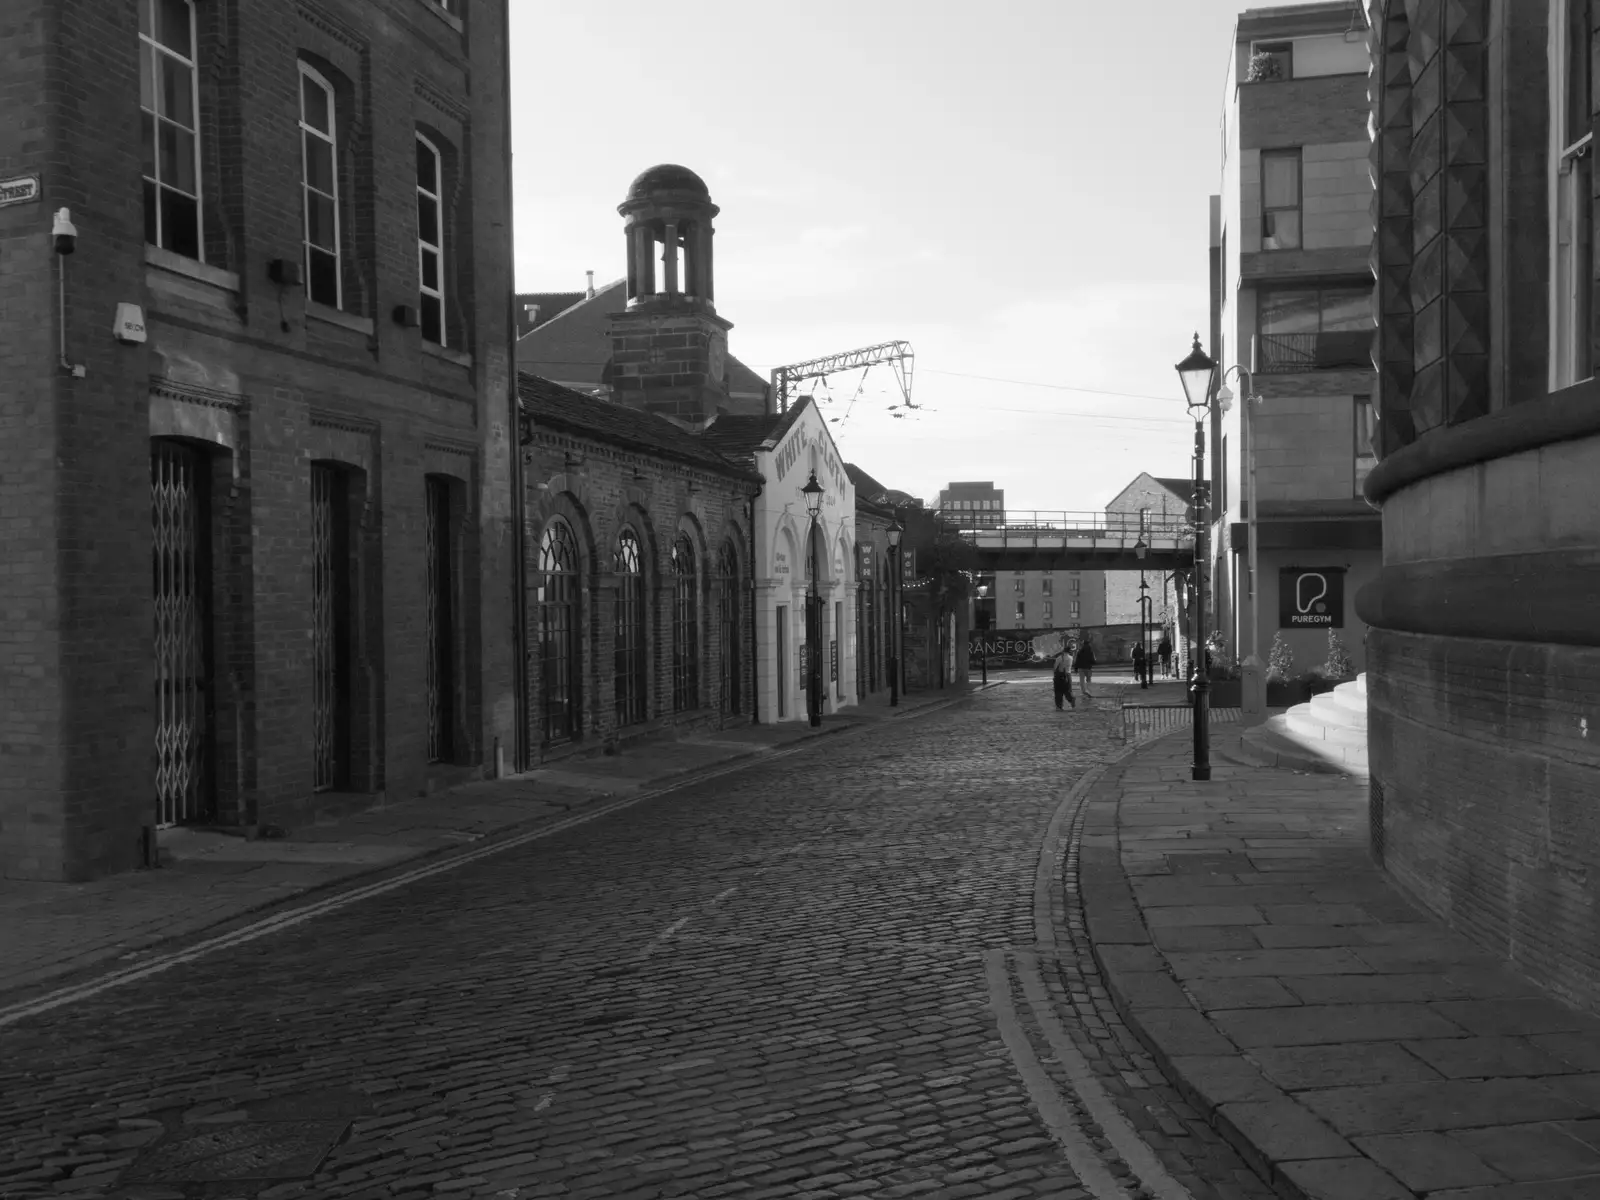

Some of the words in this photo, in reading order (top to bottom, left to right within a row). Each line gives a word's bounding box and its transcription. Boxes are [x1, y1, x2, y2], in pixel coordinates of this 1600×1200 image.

[775, 421, 808, 482] WHITE
[818, 429, 846, 501] CLOTH
[1291, 615, 1332, 623] PUREGYM
